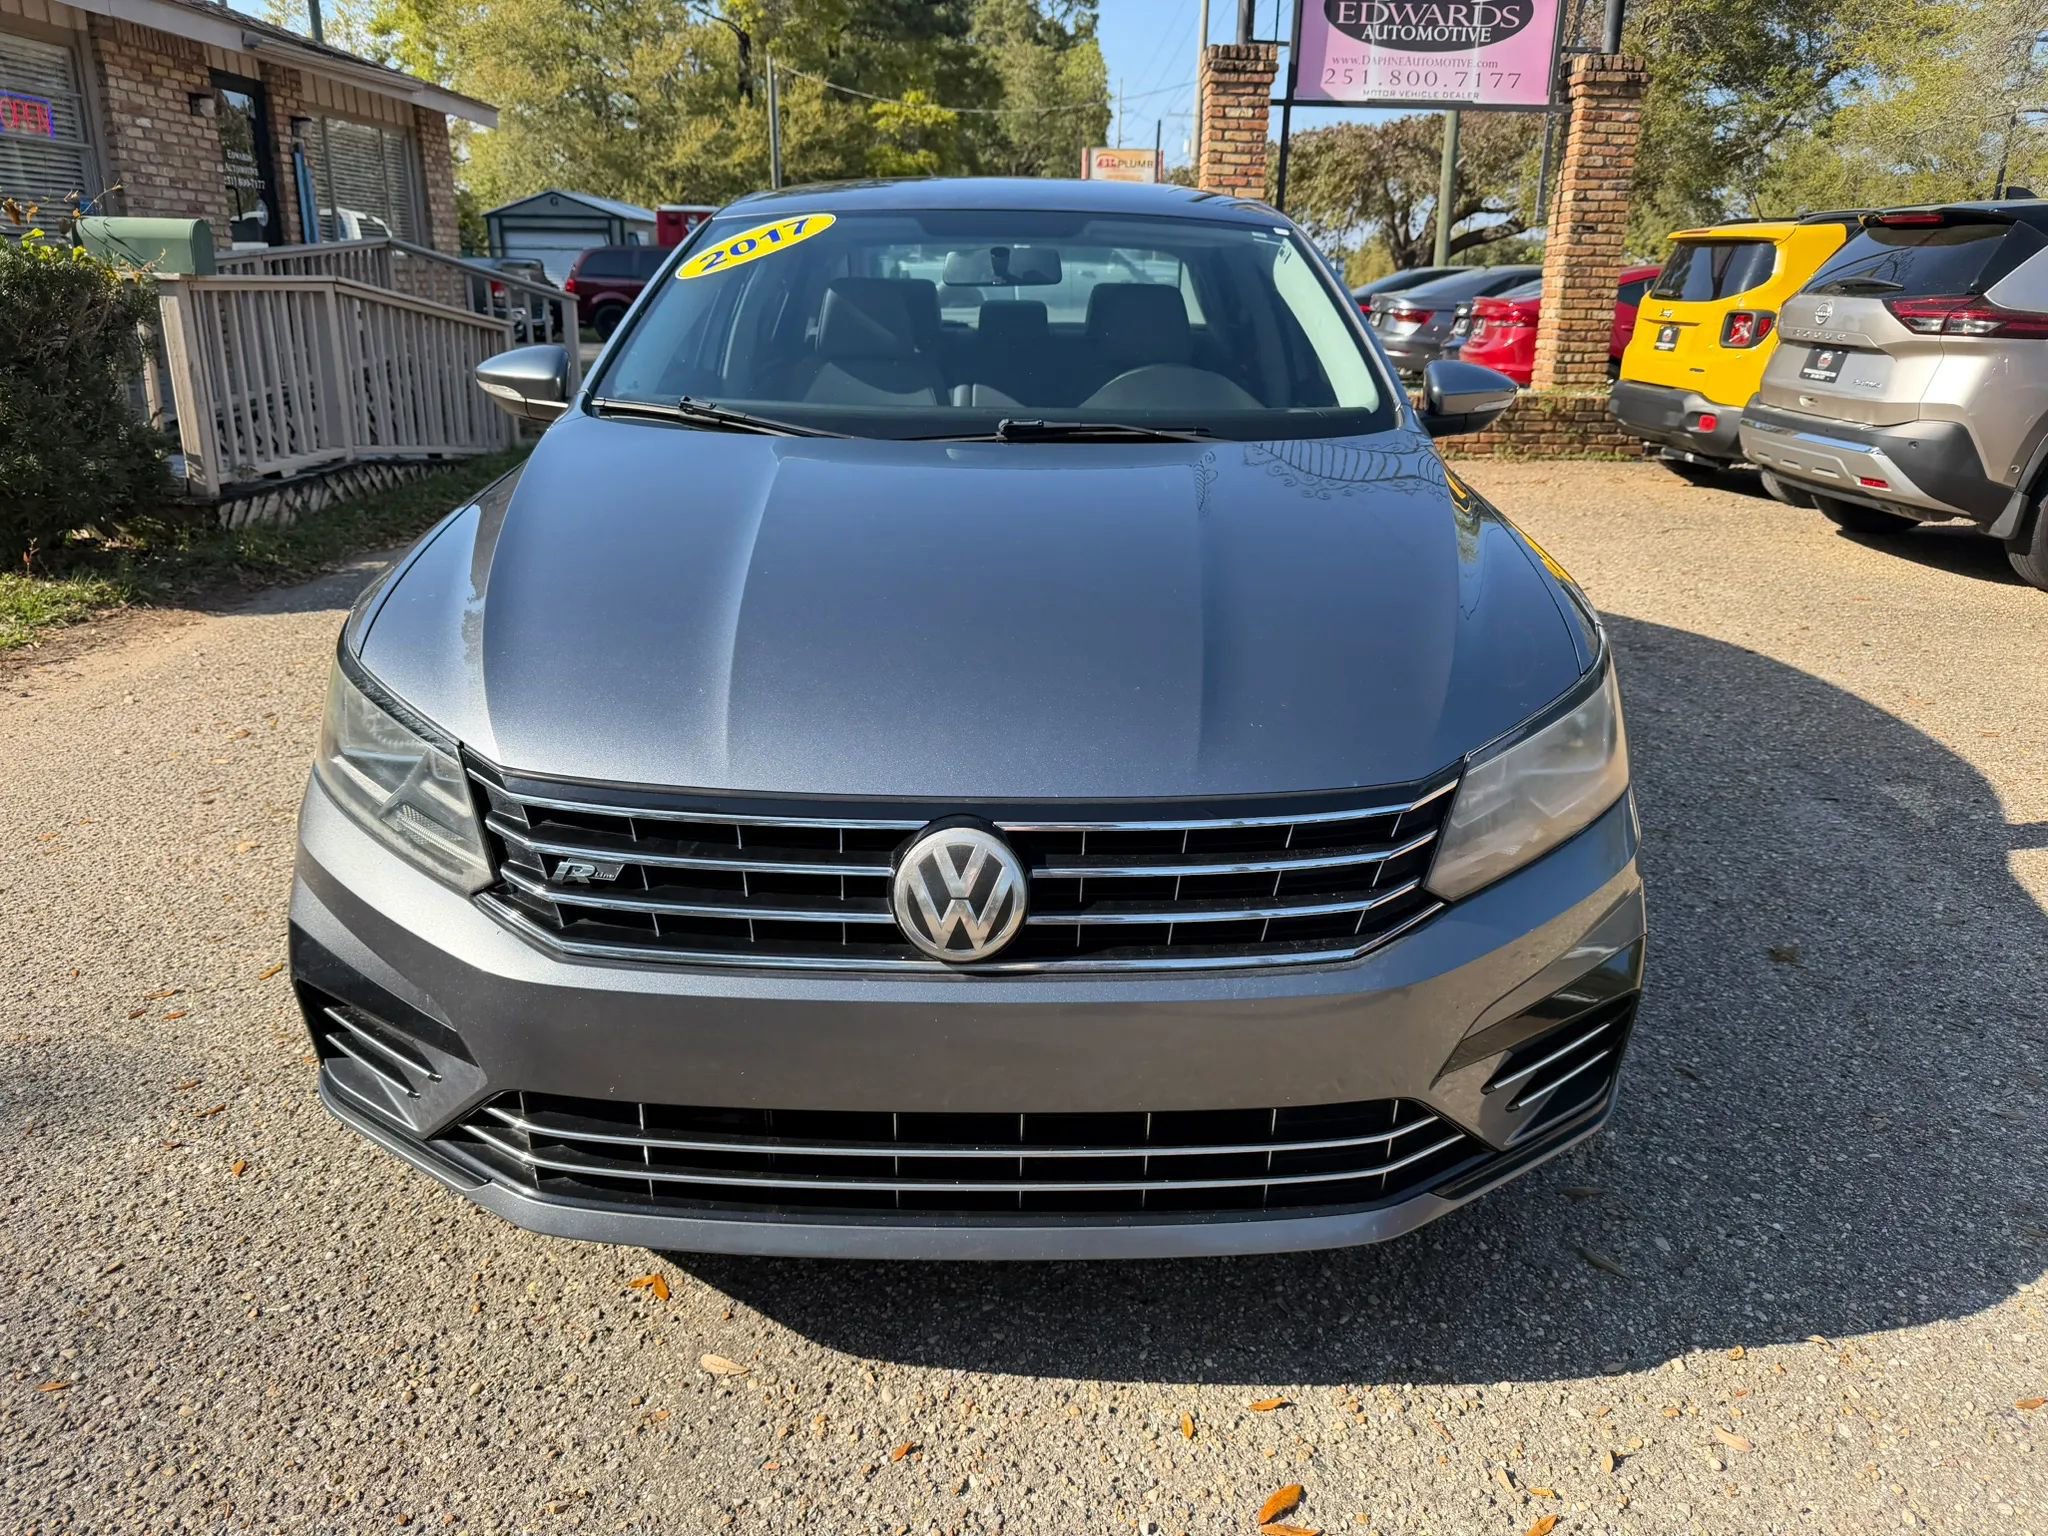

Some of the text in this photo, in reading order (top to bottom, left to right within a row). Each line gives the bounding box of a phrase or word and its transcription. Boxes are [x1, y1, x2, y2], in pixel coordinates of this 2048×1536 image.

[1337, 2, 1520, 28] EDWARDS
[1361, 24, 1491, 42] AUTOMOTIVE
[1400, 90, 1438, 99] VEHICLE
[1442, 91, 1480, 100] DEALER
[0, 97, 50, 135] OPEN
[699, 217, 812, 272] 2017
